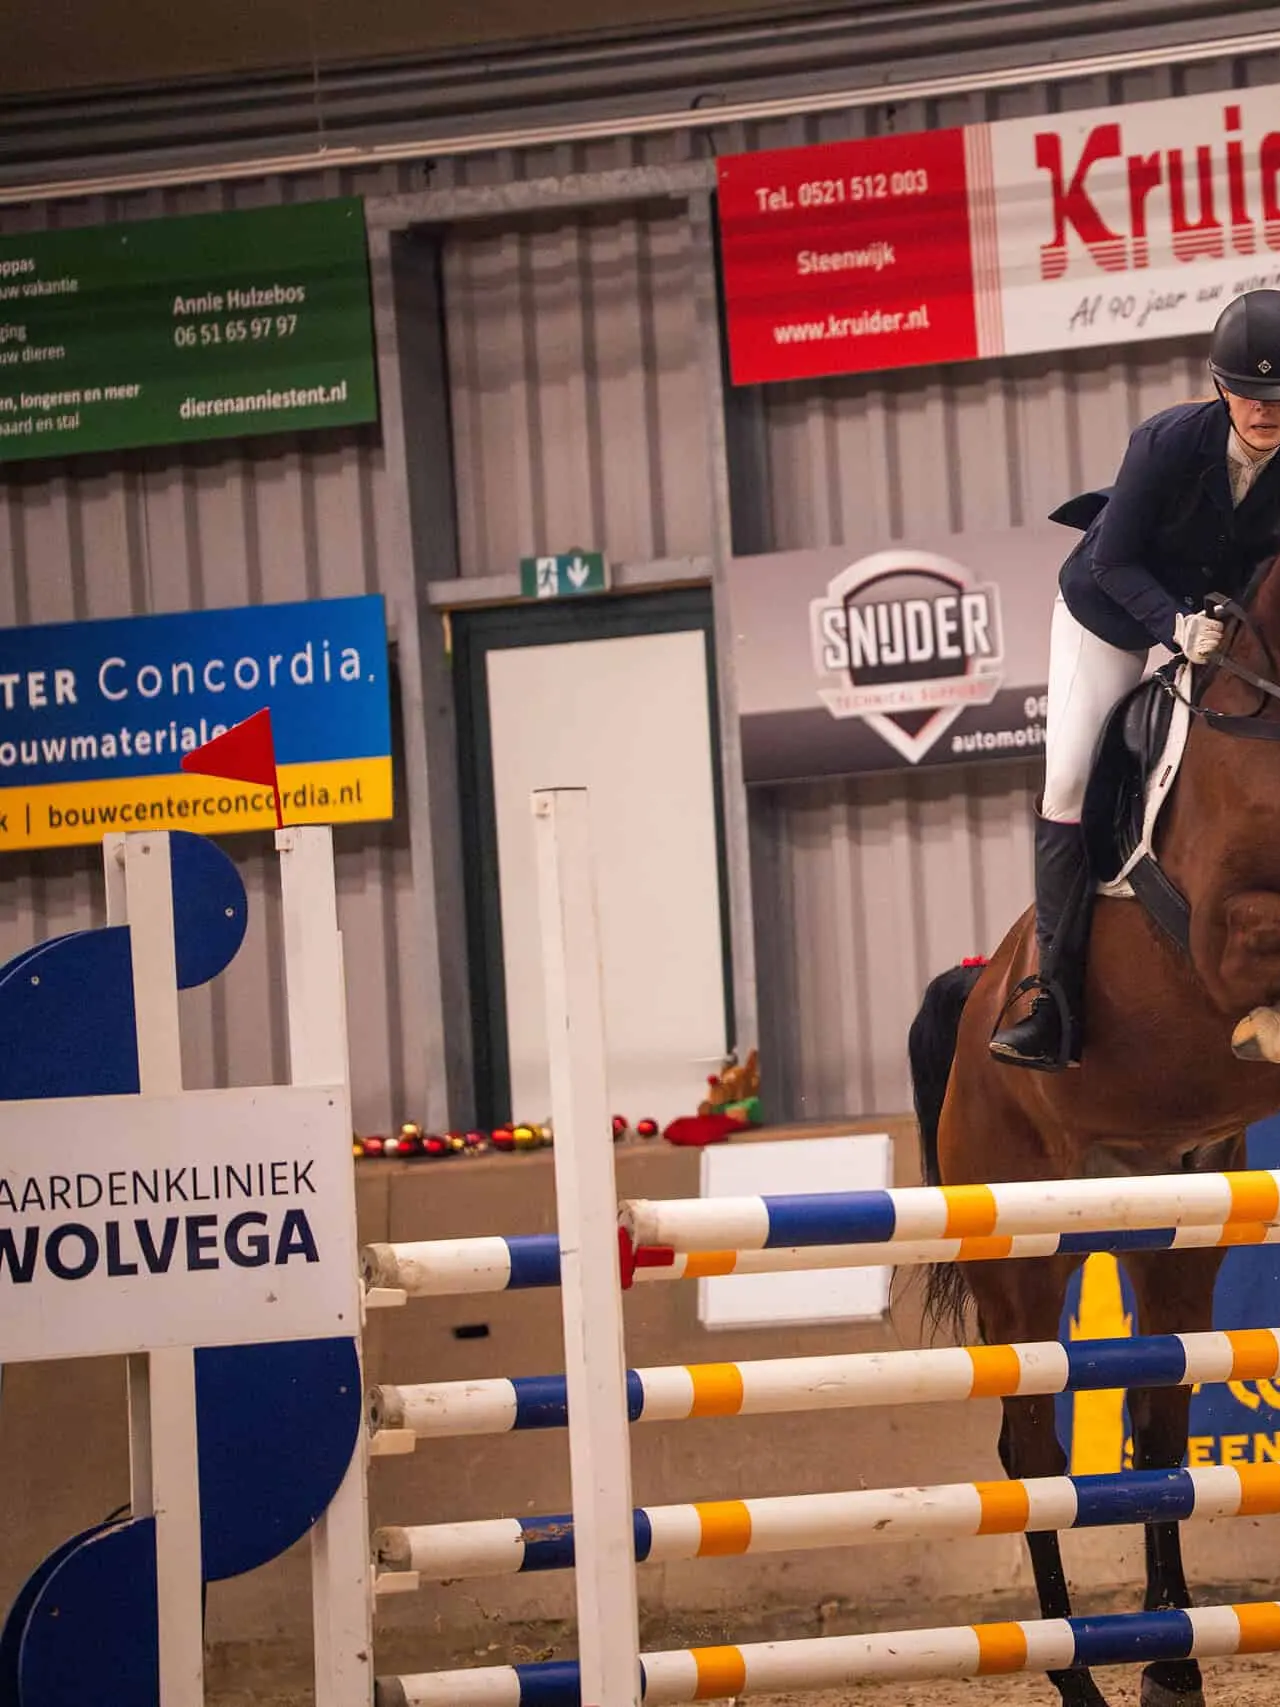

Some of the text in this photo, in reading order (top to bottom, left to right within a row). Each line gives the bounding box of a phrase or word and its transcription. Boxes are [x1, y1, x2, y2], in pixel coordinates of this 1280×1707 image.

[754, 168, 929, 212] Tel. 0521 512 003
[797, 241, 896, 275] Steenwijk
[22, 275, 79, 297] vakantie
[173, 292, 224, 316] Annie
[174, 314, 298, 347] 06 51 65 97 97
[772, 303, 931, 345] www.kruider.nl
[1067, 296, 1100, 331] Al
[1108, 297, 1138, 319] 90
[1137, 289, 1192, 328] jaar
[22, 345, 65, 363] dieren
[20, 391, 80, 411] longeren
[84, 387, 101, 403] en
[104, 384, 140, 400] meer
[179, 380, 347, 419] dierenanniestent.nl
[0, 411, 79, 437] aard en stal
[823, 593, 991, 669] SNIJDER
[0, 640, 375, 709] TER Concordia.
[0, 718, 243, 766] ouwmateriale
[49, 779, 362, 829] bouwcenterconcordia.nl
[0, 1159, 317, 1213] AARDENKLINIEK
[0, 1209, 320, 1284] WOLVEGA
